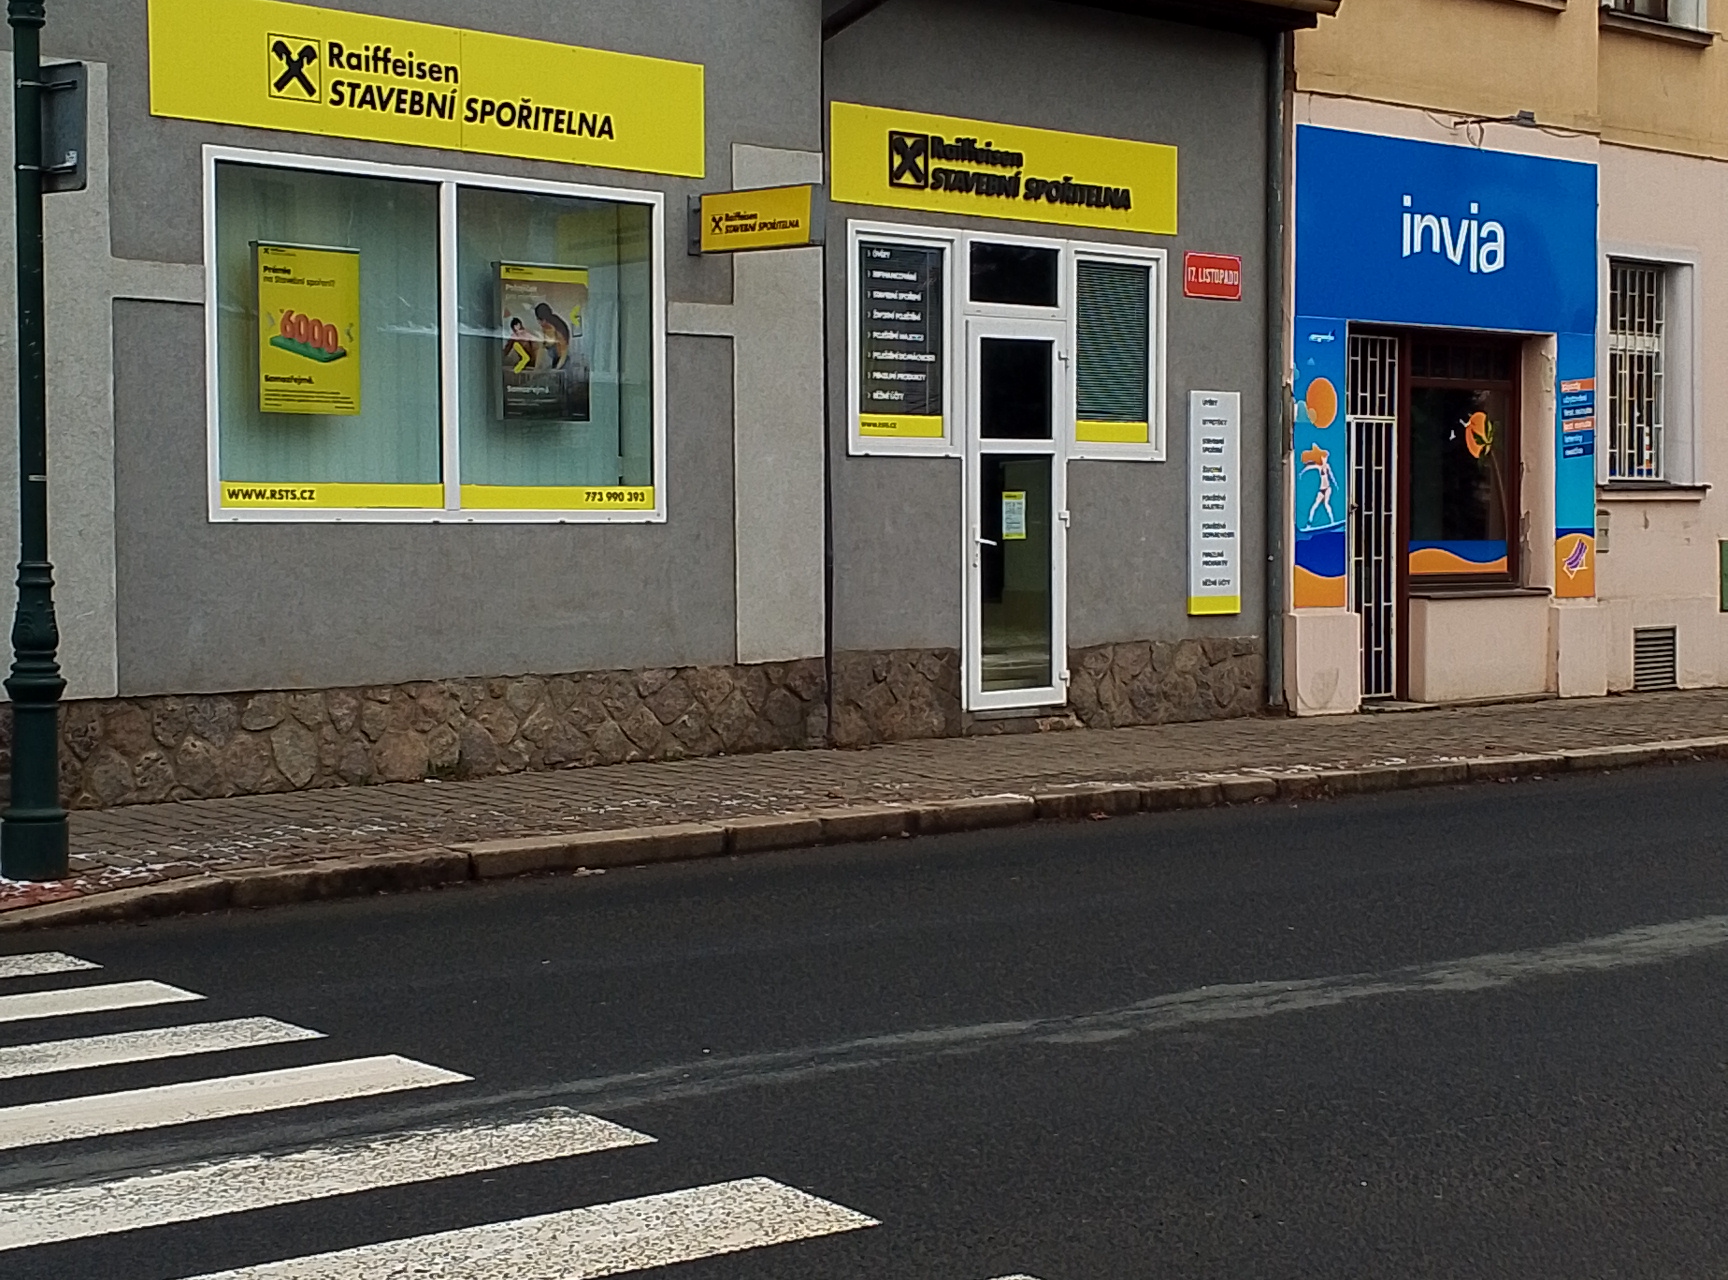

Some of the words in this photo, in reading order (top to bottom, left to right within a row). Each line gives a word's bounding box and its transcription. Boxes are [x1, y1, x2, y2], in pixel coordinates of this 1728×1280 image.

[328, 41, 459, 84] Raiffeisen
[329, 80, 457, 120] STAVEBNÍ
[463, 97, 614, 140] SPOŘITELNA
[930, 136, 1023, 168] Raiffeisen
[930, 168, 1022, 198] STAVEBNÍ
[1023, 176, 1132, 210] SPOŘITELNA
[1402, 194, 1505, 274] invia
[1188, 266, 1198, 282] 17.
[1198, 267, 1239, 285] LISTOPADU
[281, 309, 338, 354] 6000
[226, 488, 316, 501] WWW.RSTS.CZ
[585, 491, 604, 502] 773
[606, 491, 625, 502] 990
